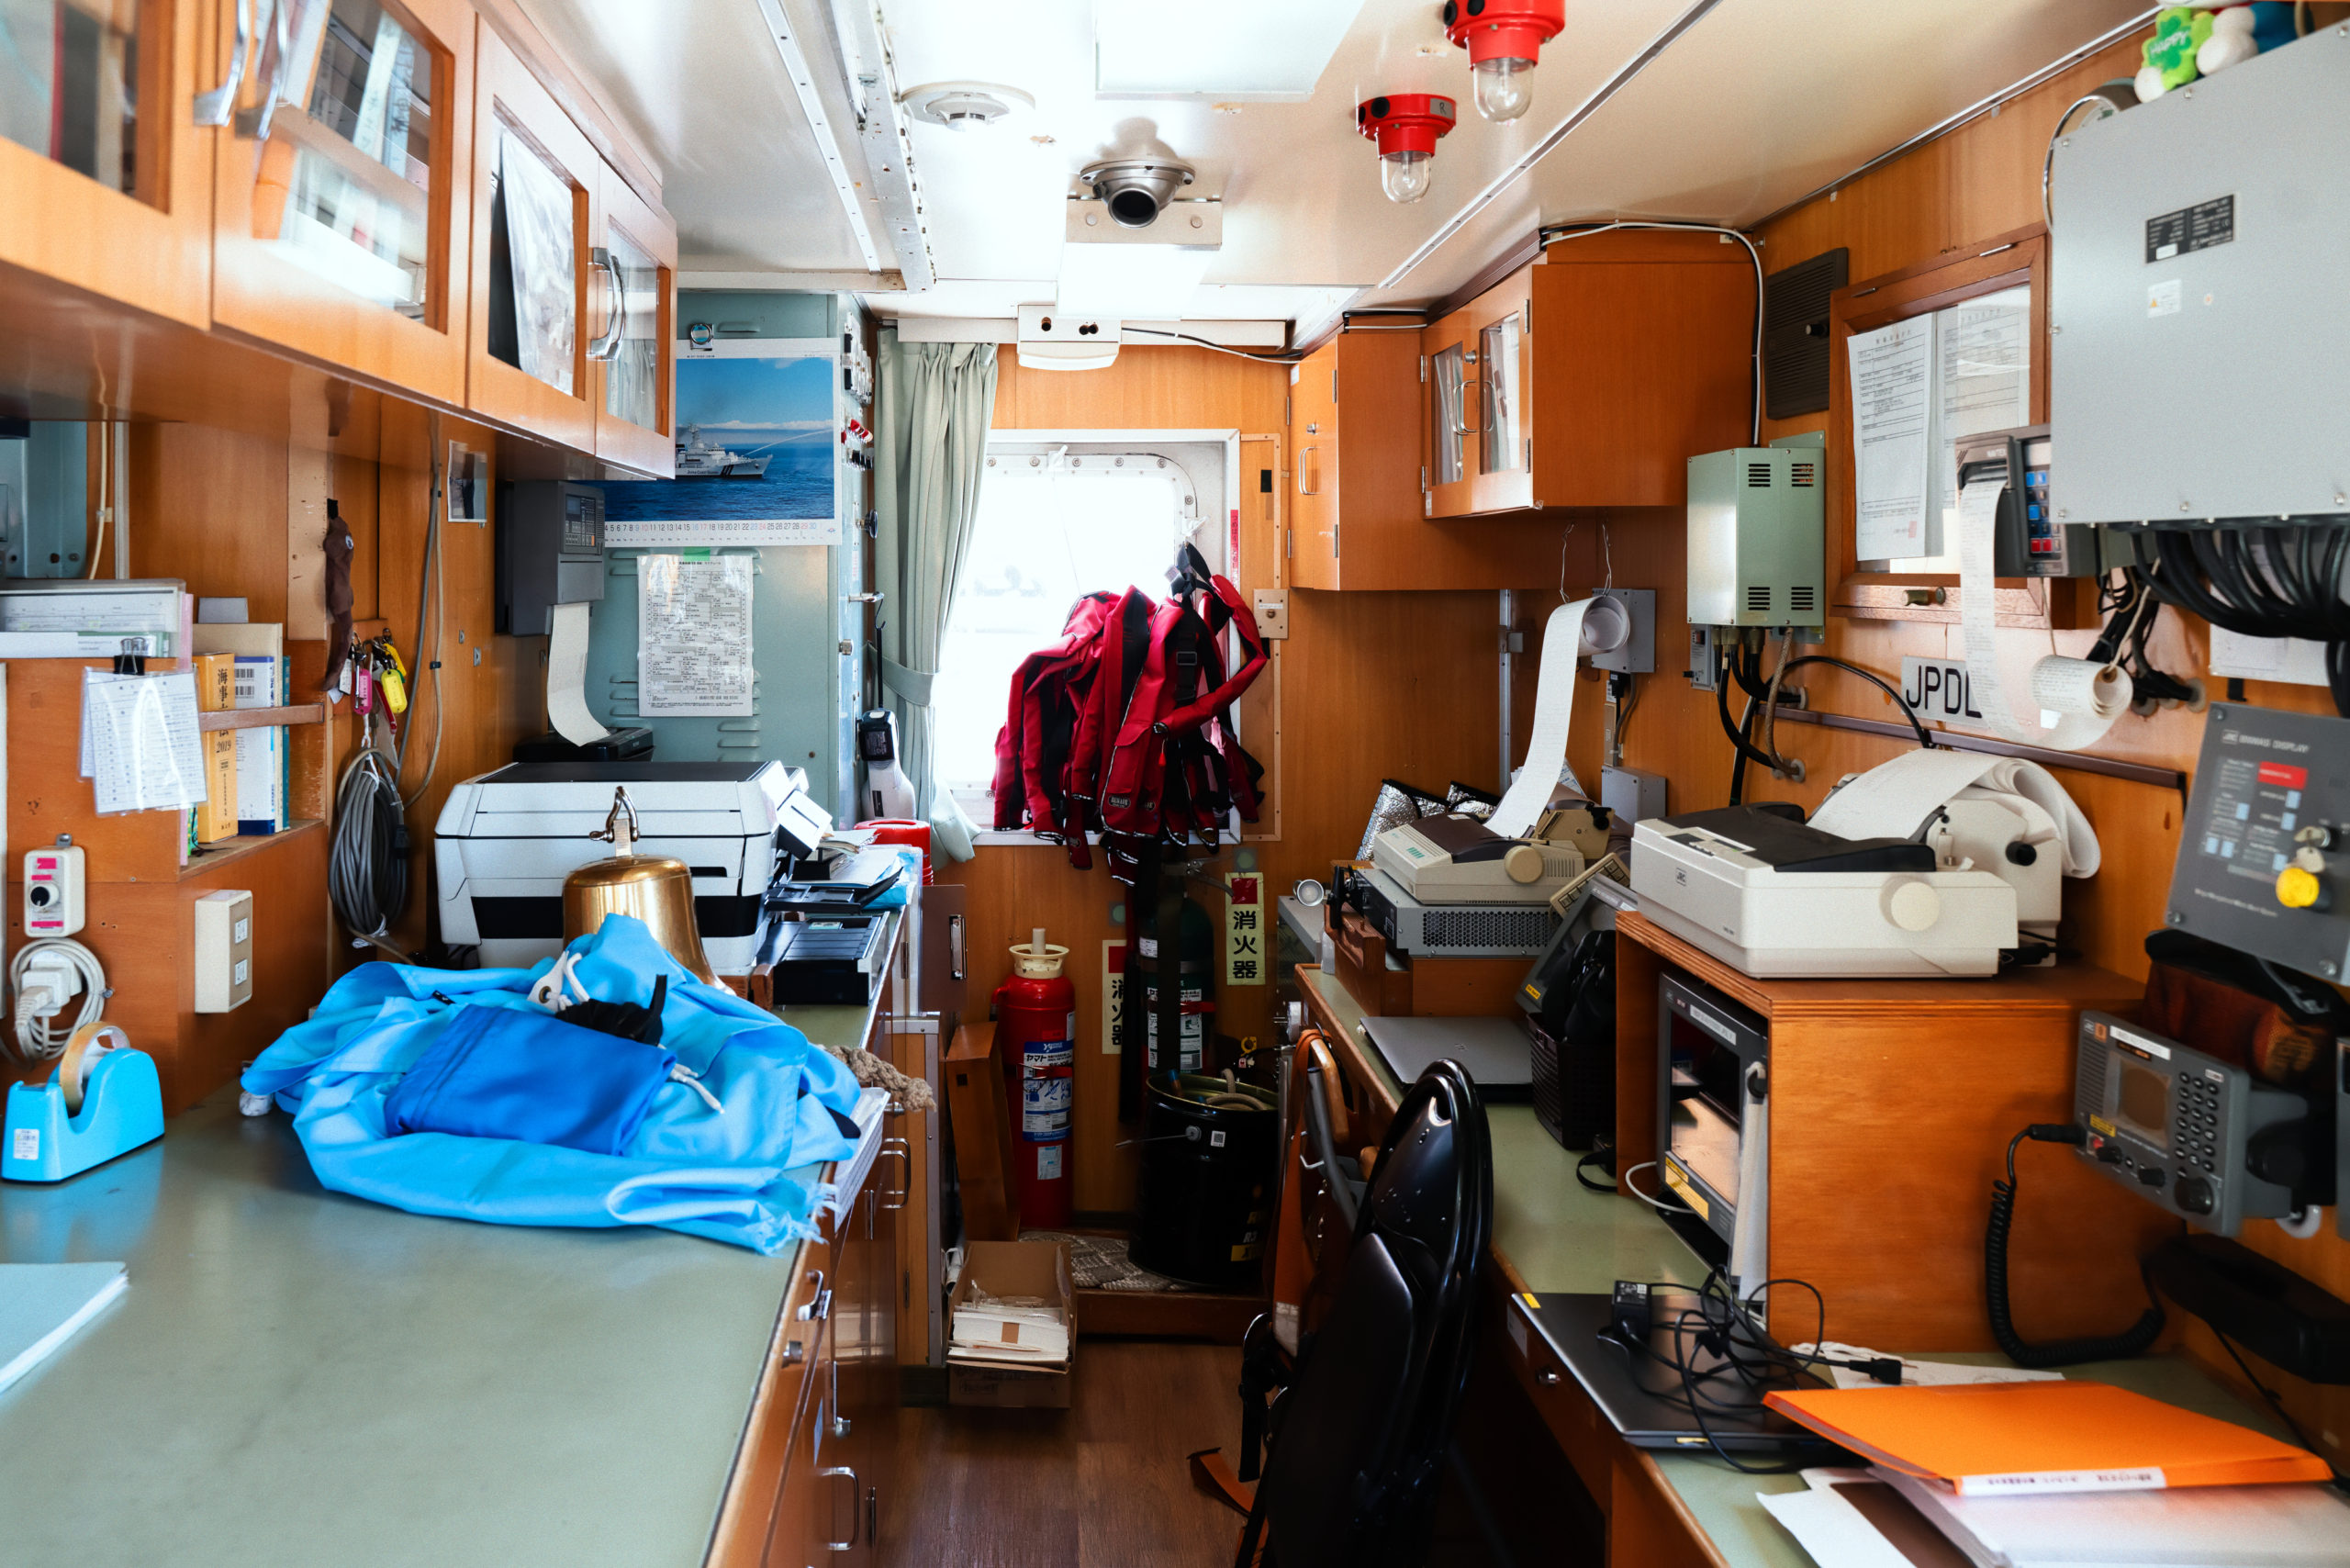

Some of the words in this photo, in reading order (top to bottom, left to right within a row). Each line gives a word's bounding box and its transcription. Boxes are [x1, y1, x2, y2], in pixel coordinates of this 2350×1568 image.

[1438, 102, 1447, 115] R
[1906, 665, 1982, 719] JPDL
[216, 739, 231, 753] 2019
[1233, 910, 1257, 979] 消火器
